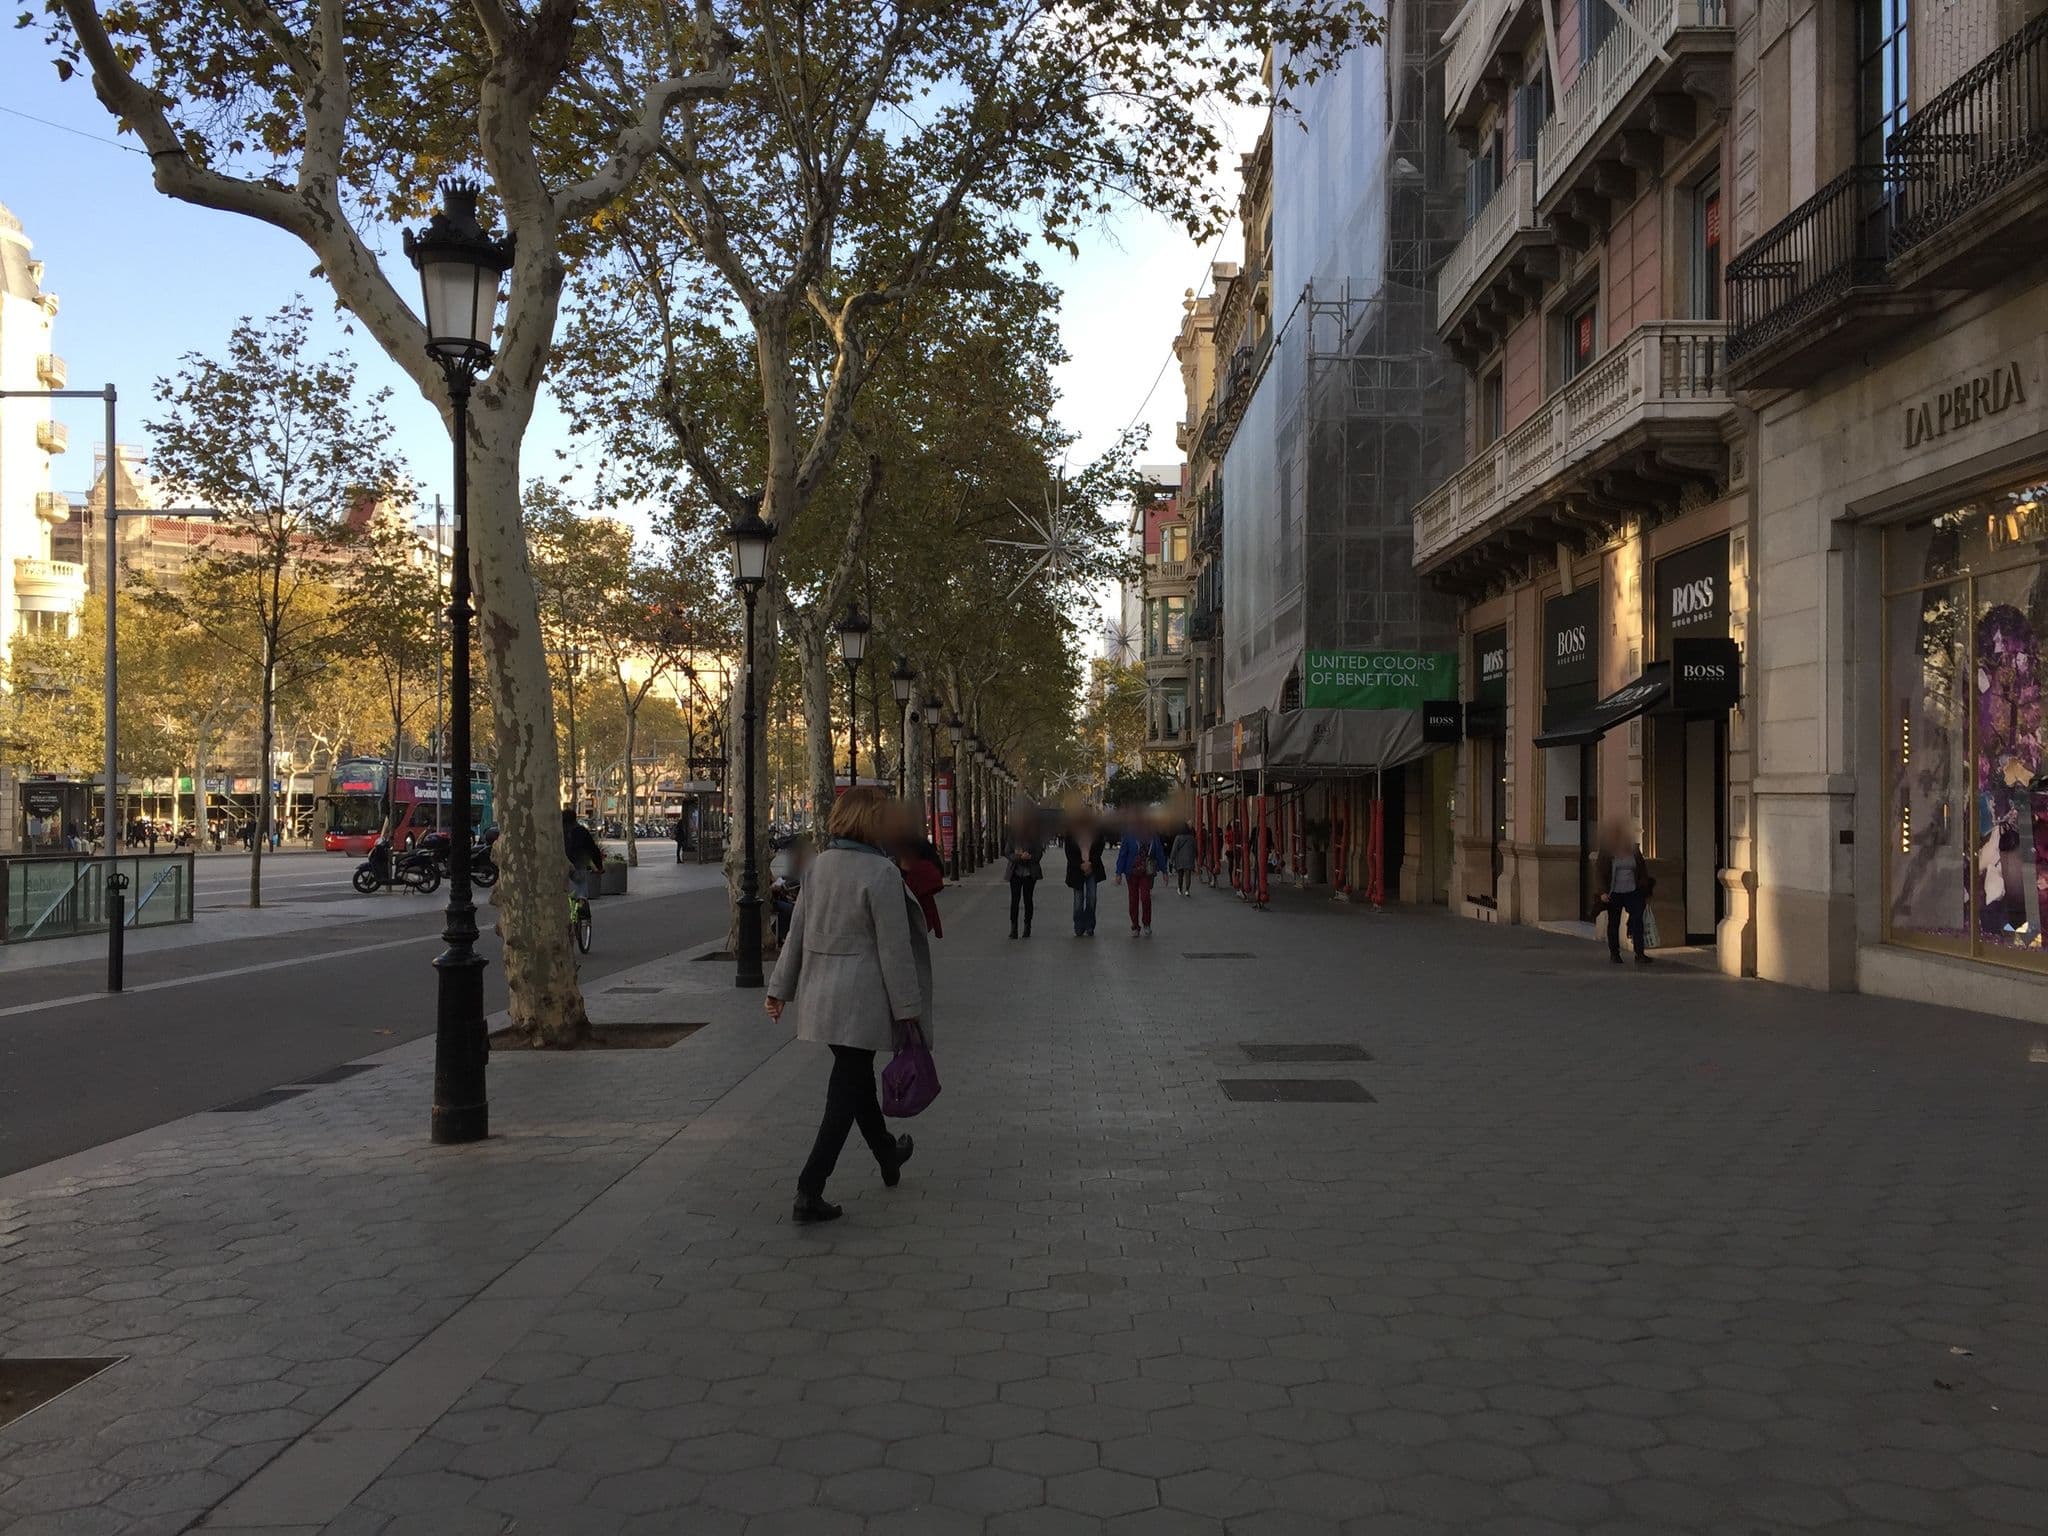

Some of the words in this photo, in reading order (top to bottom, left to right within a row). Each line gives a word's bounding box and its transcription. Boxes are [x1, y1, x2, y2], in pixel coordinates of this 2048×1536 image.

[1671, 576, 1714, 618] BOSS
[1557, 625, 1586, 657] BOSS
[1311, 655, 1369, 670] UNITED
[1372, 656, 1436, 671] COLORS
[1482, 648, 1504, 674] BOSS
[1683, 664, 1726, 678] BOSS
[1310, 672, 1332, 686] OF
[1335, 672, 1419, 687] BENETTON.
[1429, 715, 1455, 725] BOSS
